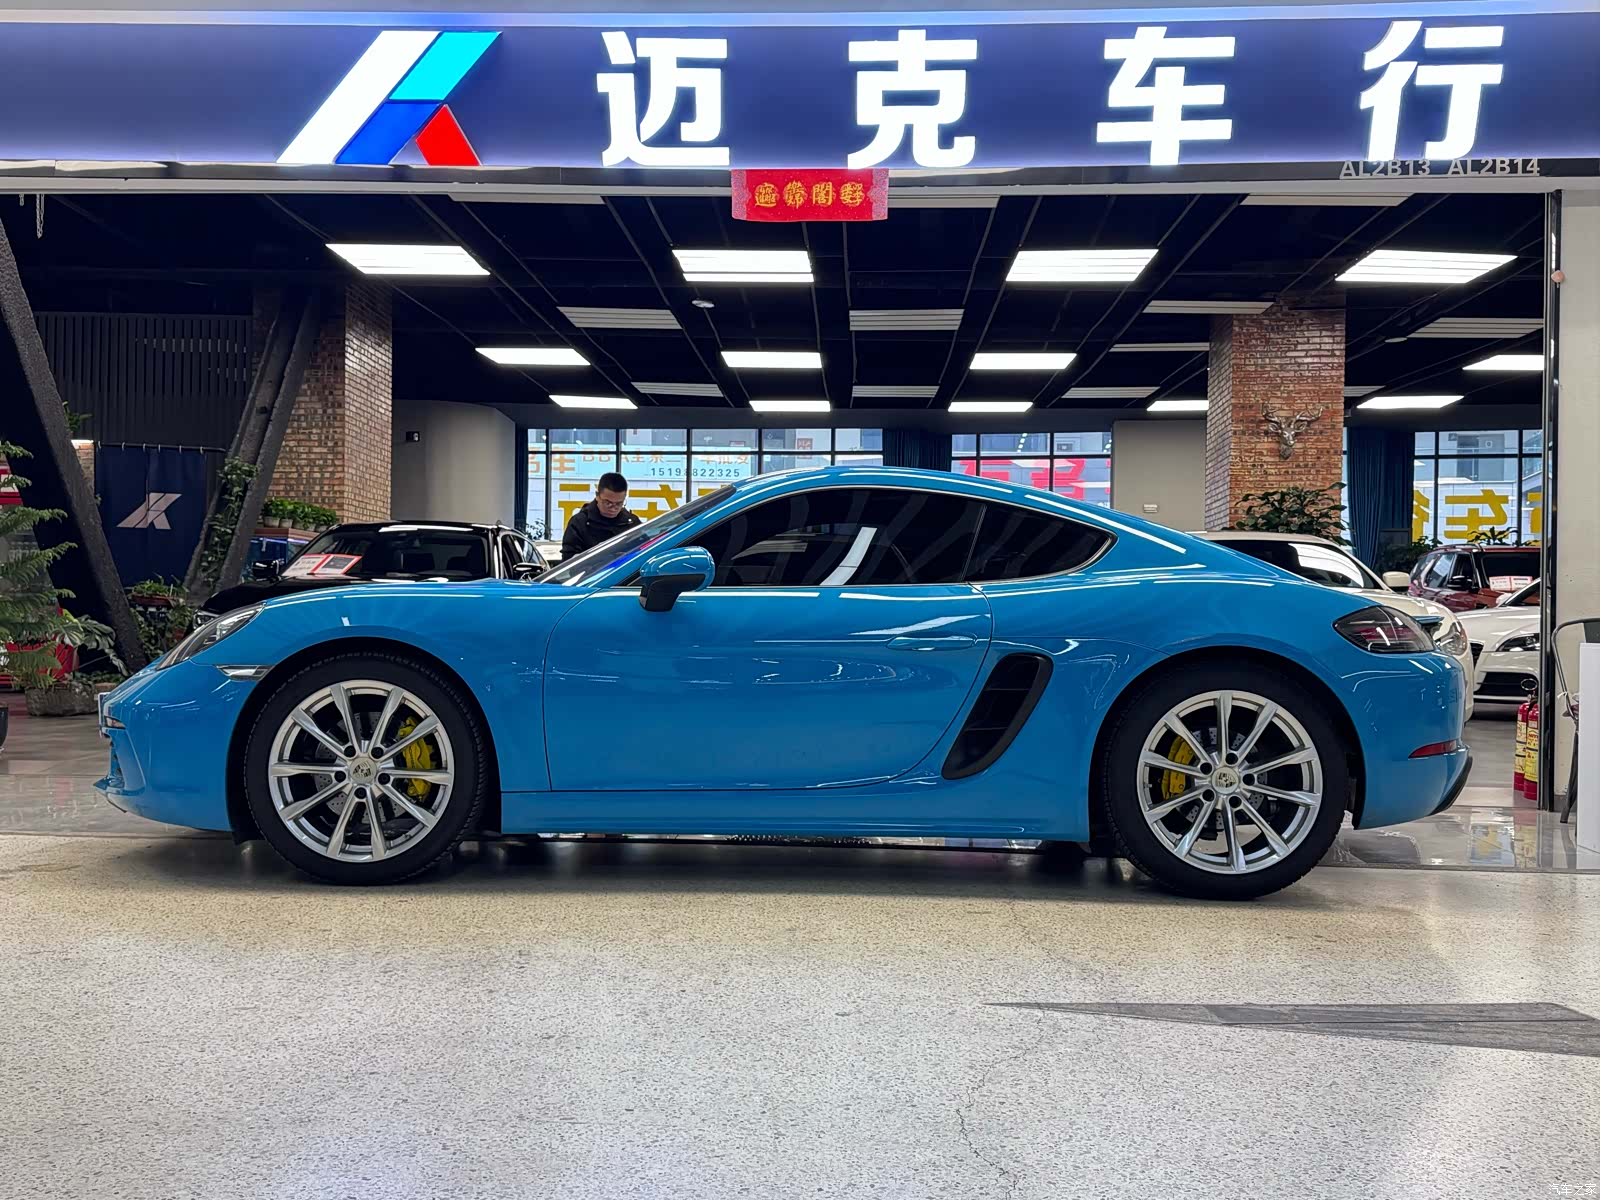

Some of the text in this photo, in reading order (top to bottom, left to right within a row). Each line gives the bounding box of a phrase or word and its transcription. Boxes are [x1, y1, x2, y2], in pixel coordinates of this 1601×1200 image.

[597, 20, 1504, 169] 迈克车行
[1339, 157, 1541, 179] AL2B13 AL2B14
[650, 467, 741, 478] 1519822325
